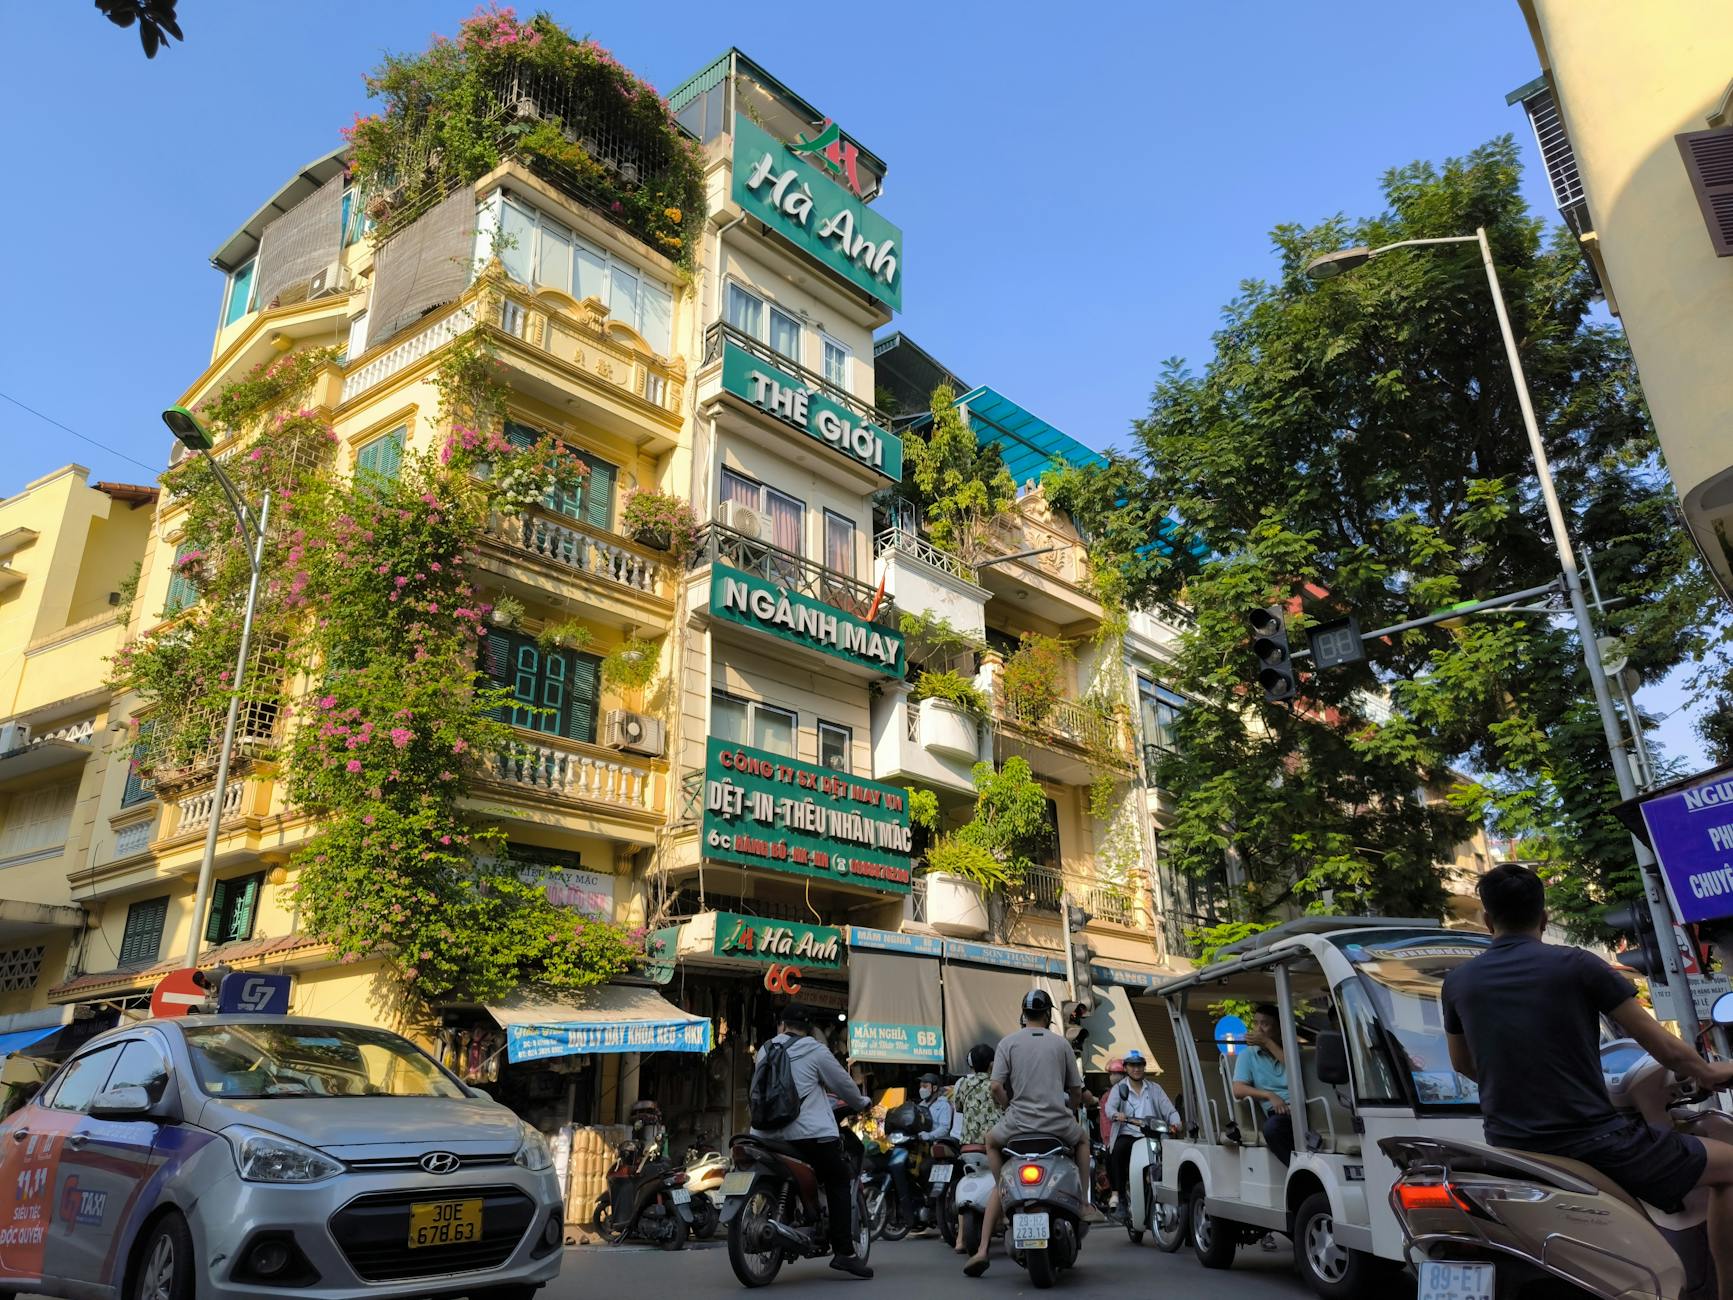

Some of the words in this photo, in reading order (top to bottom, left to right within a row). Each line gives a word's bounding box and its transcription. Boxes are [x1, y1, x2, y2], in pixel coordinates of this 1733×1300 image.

[746, 152, 814, 225] Hà
[818, 208, 897, 284] Anh
[751, 369, 813, 427] THẾ
[816, 410, 882, 467] GIỚI
[725, 576, 837, 643] NGÀNH
[845, 622, 899, 665] MAY
[719, 748, 773, 778] CÔNG
[778, 764, 794, 783] TY
[798, 770, 818, 790] SX
[851, 784, 882, 806] MAY
[760, 926, 794, 955] Hà
[794, 931, 838, 961] Anh
[242, 977, 276, 1011] G7
[764, 963, 802, 995] 6C
[916, 1030, 937, 1046] 6B
[80, 1191, 106, 1217] TAXI
[433, 1203, 464, 1222] 30E
[417, 1222, 474, 1244] 678.63
